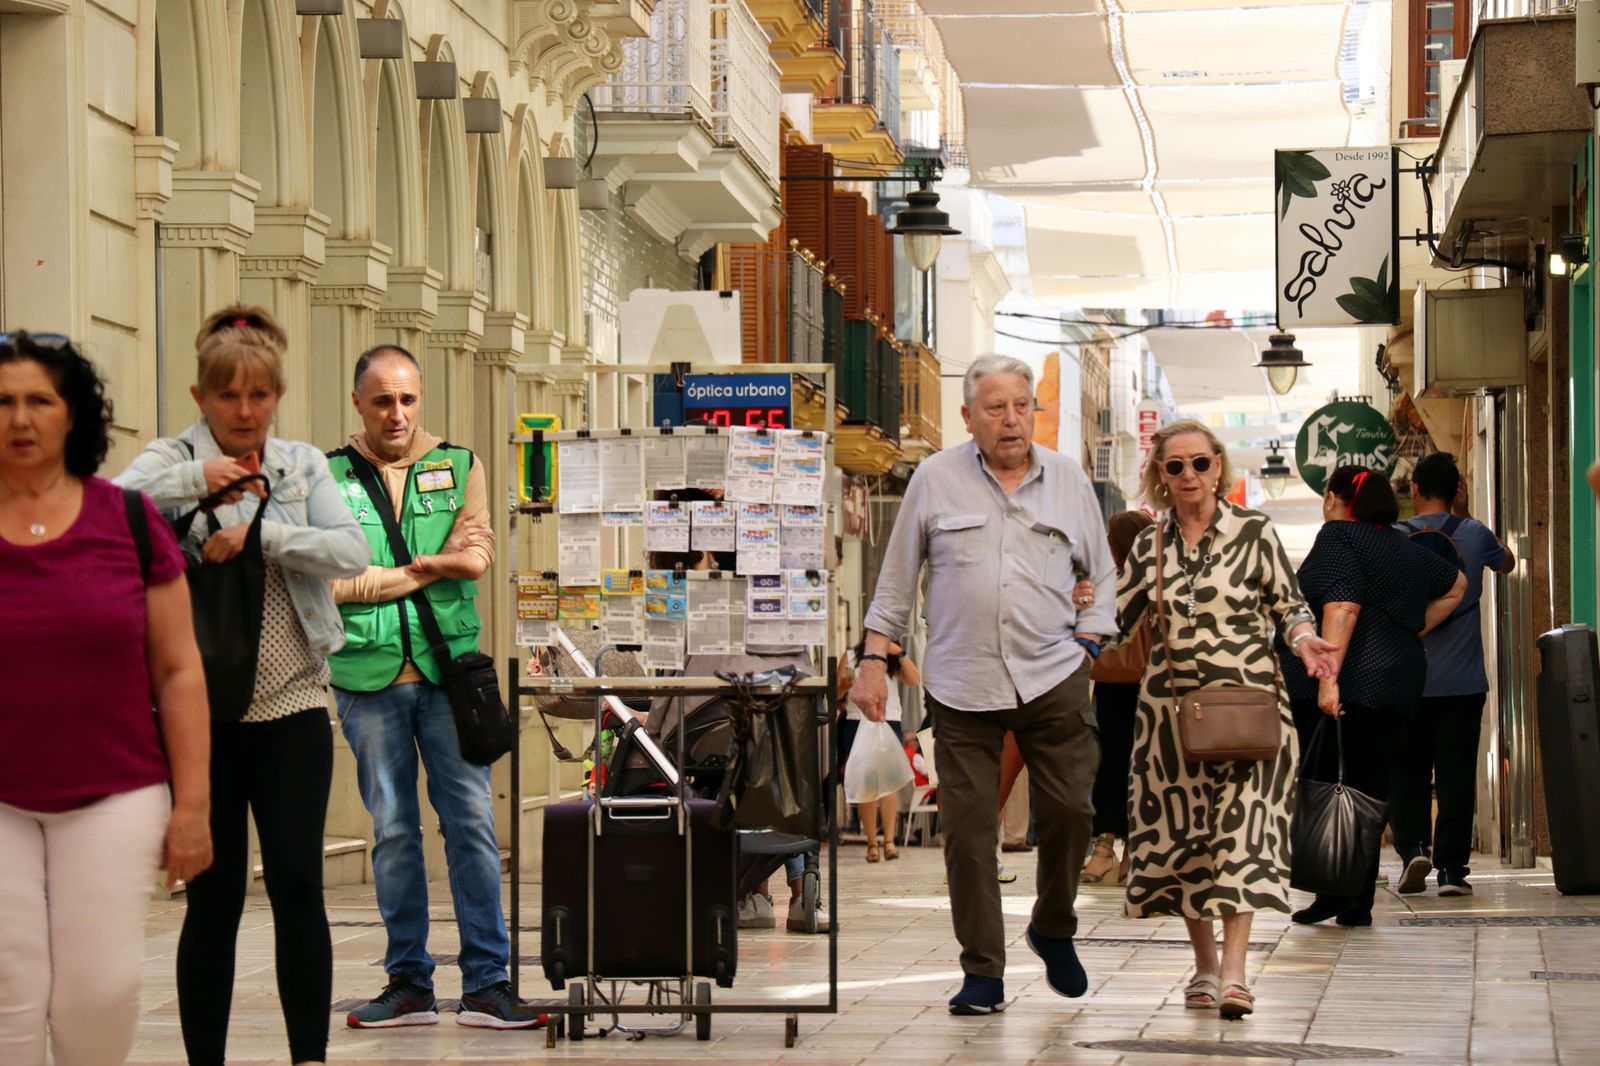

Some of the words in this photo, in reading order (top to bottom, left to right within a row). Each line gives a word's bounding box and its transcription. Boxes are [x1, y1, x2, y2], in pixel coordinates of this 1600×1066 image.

[1335, 152, 1364, 161] Desde
[1367, 152, 1389, 160] 1992
[687, 383, 733, 400] óptica
[736, 383, 786, 396] urbano
